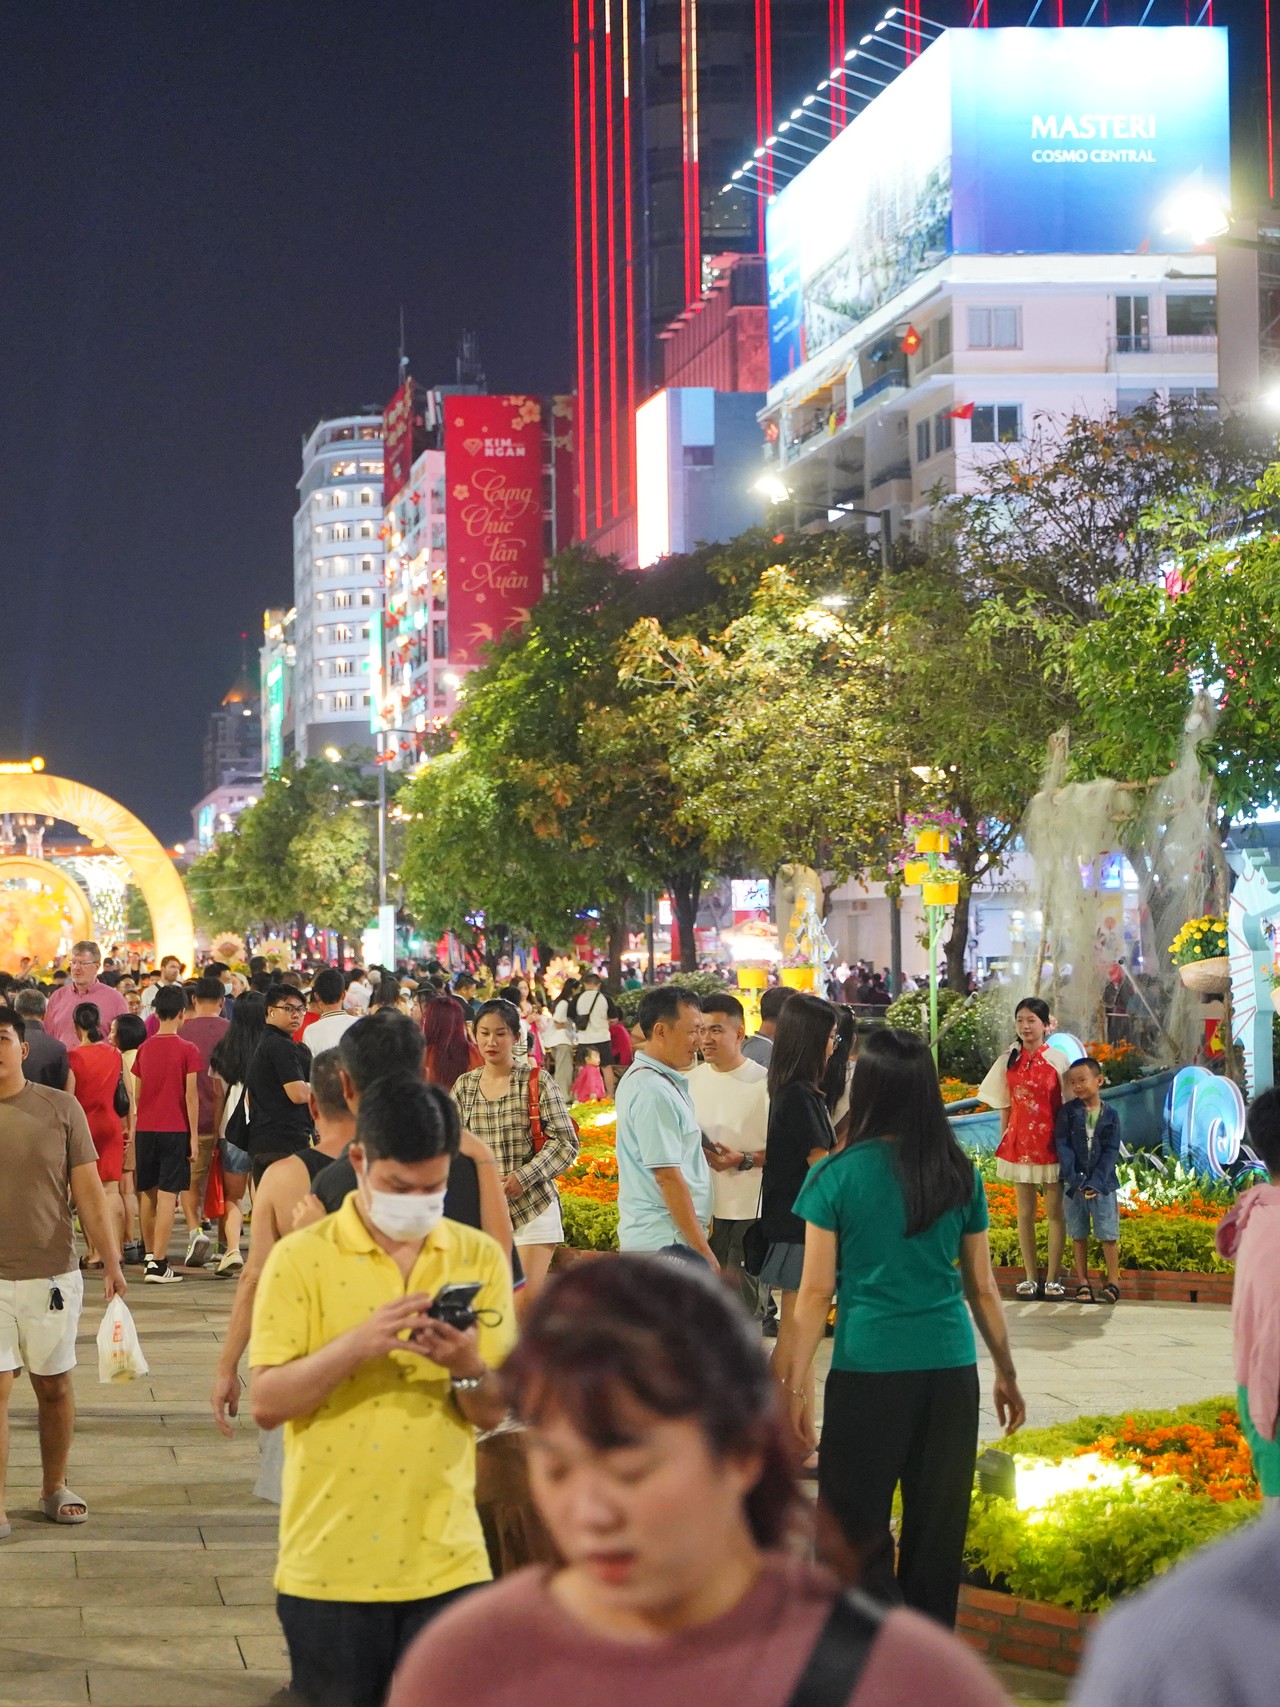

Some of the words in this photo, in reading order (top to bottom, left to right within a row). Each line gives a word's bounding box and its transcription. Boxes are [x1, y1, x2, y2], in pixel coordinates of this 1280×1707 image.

[1031, 114, 1157, 139] MASTERI
[1031, 149, 1089, 163] COSMO
[1090, 149, 1157, 163] CENTRAL
[484, 438, 512, 447] KIM
[484, 448, 526, 457] NGAN
[462, 562, 529, 598] Xuân
